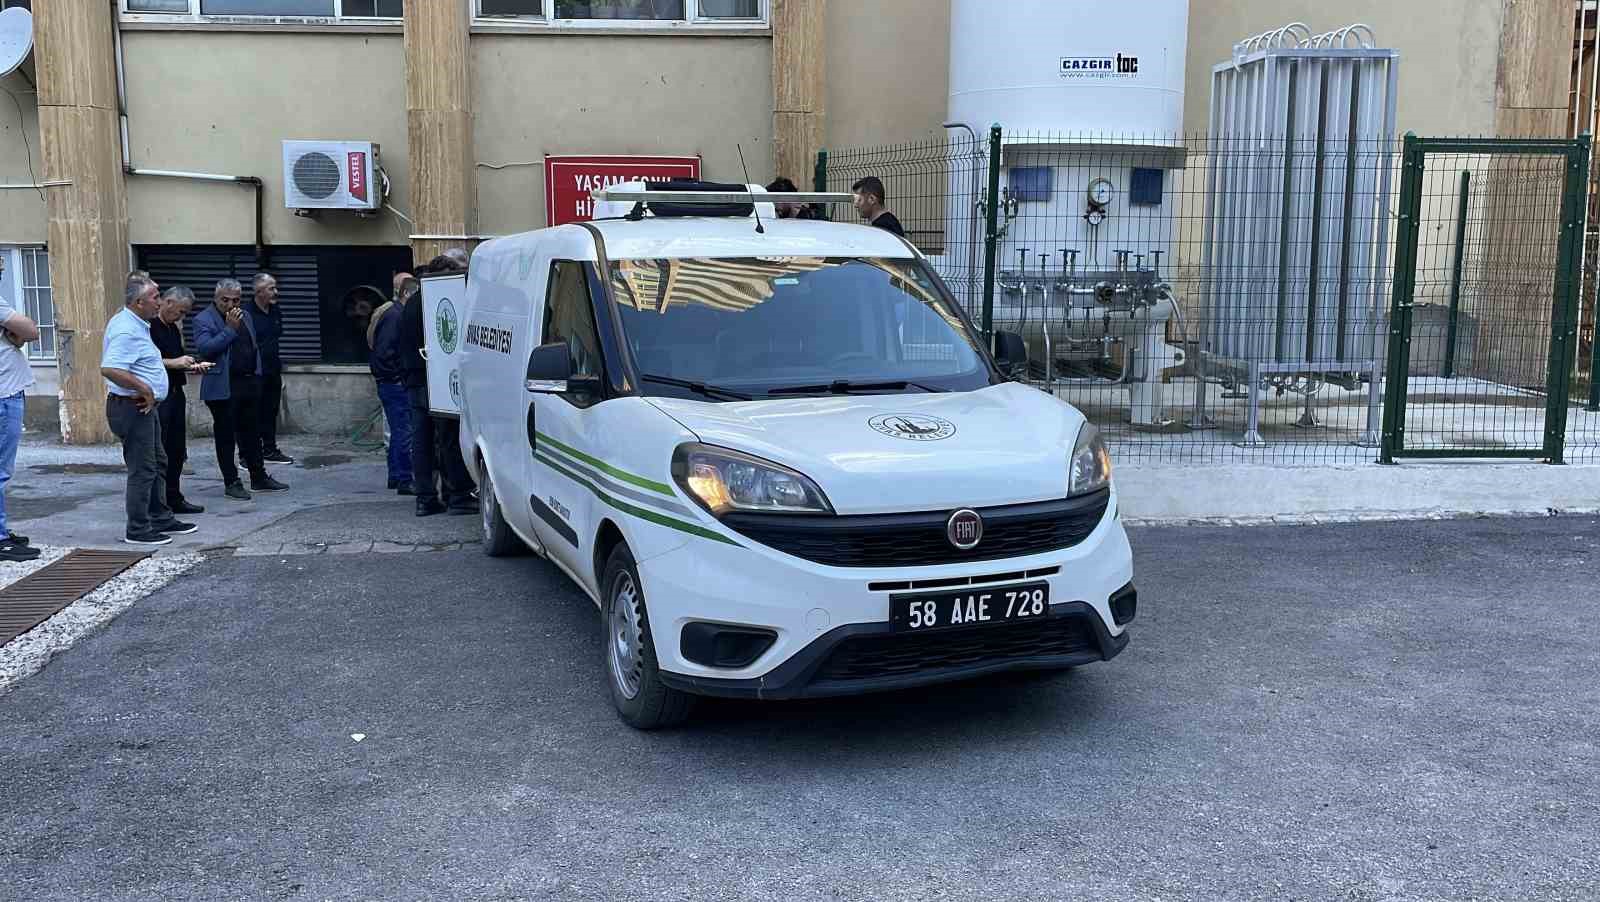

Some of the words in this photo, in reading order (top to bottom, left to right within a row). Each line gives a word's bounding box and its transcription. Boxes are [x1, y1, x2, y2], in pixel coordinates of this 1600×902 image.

[1062, 60, 1112, 69] CAZGIR
[351, 155, 361, 189] VESTEL
[956, 520, 977, 539] FIAT
[909, 601, 937, 628] 58
[951, 594, 992, 624] AAE
[1005, 589, 1044, 618] 728
